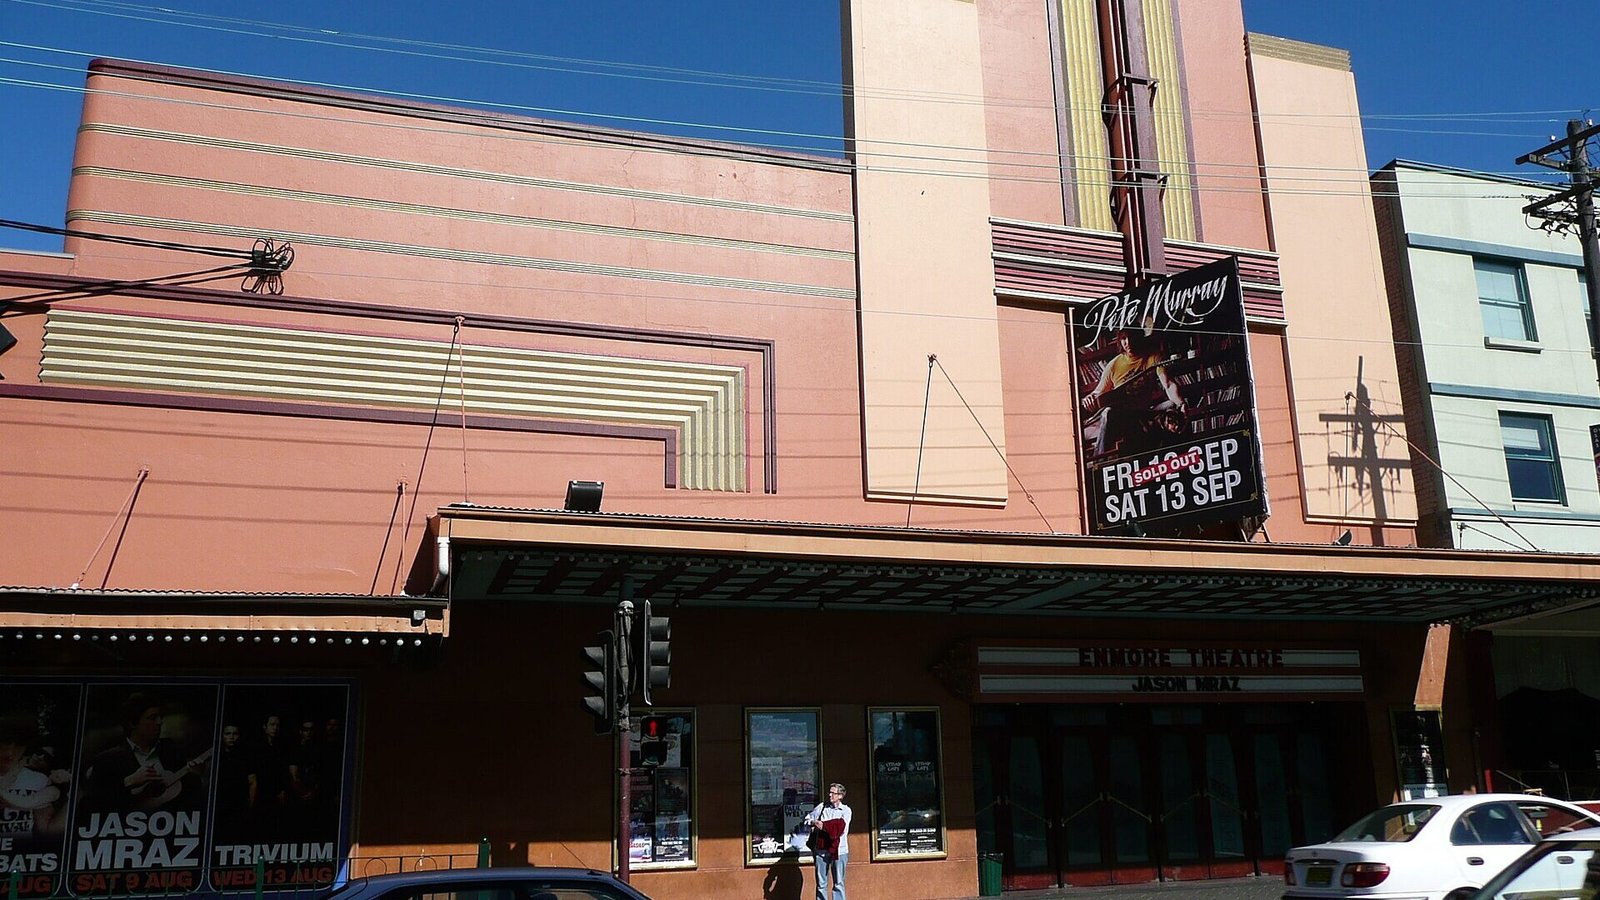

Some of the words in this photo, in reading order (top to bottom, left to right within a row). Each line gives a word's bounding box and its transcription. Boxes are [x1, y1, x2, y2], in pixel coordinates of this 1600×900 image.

[1083, 294, 1141, 348] Pete
[1141, 274, 1228, 332] Murray
[1102, 462, 1139, 493] FRI
[1187, 437, 1239, 473] SEP
[1134, 463, 1168, 485] SOLD
[1172, 451, 1198, 469] OUT
[1105, 489, 1149, 524] SAT
[1155, 481, 1186, 512] 13
[1192, 469, 1242, 505] SEP
[1078, 648, 1171, 667] ENMORE
[1188, 648, 1284, 668] THEATRE
[1132, 676, 1188, 692] JASON
[1195, 677, 1242, 692] MRAZ
[78, 810, 201, 838] JASON
[75, 837, 200, 870] MRAZ
[215, 842, 334, 866] TRIVIUM
[76, 872, 119, 891] SAT
[125, 871, 139, 889] 9
[145, 870, 193, 889] AUG
[213, 869, 257, 887] WED
[264, 868, 287, 885] 13
[289, 866, 334, 884] AUG
